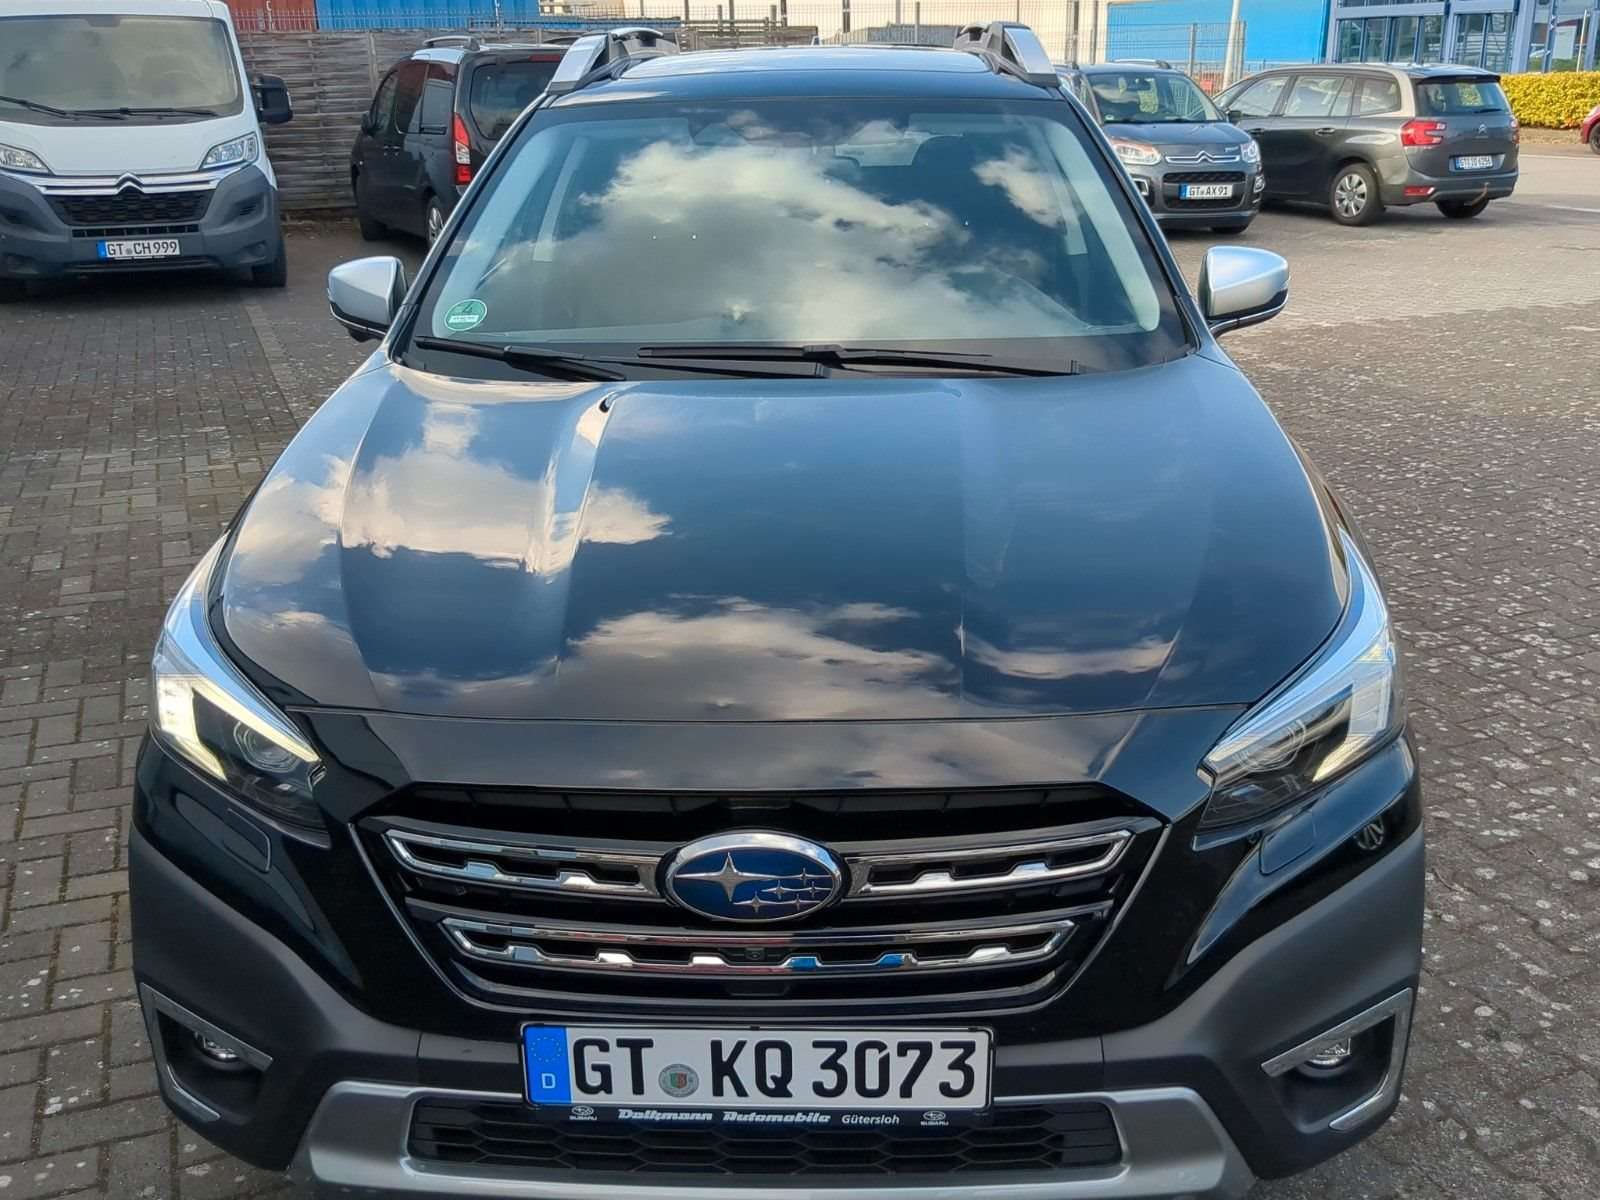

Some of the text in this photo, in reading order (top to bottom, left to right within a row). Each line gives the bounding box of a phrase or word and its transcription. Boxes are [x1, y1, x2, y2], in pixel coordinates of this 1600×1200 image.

[107, 241, 177, 255] GT CH 999
[573, 1038, 654, 1095] GT
[710, 1040, 793, 1098] KQ
[812, 1040, 976, 1098] 3073
[541, 1073, 556, 1089] D
[723, 1111, 831, 1123] Automobile
[841, 1114, 900, 1125] Gütersloh
